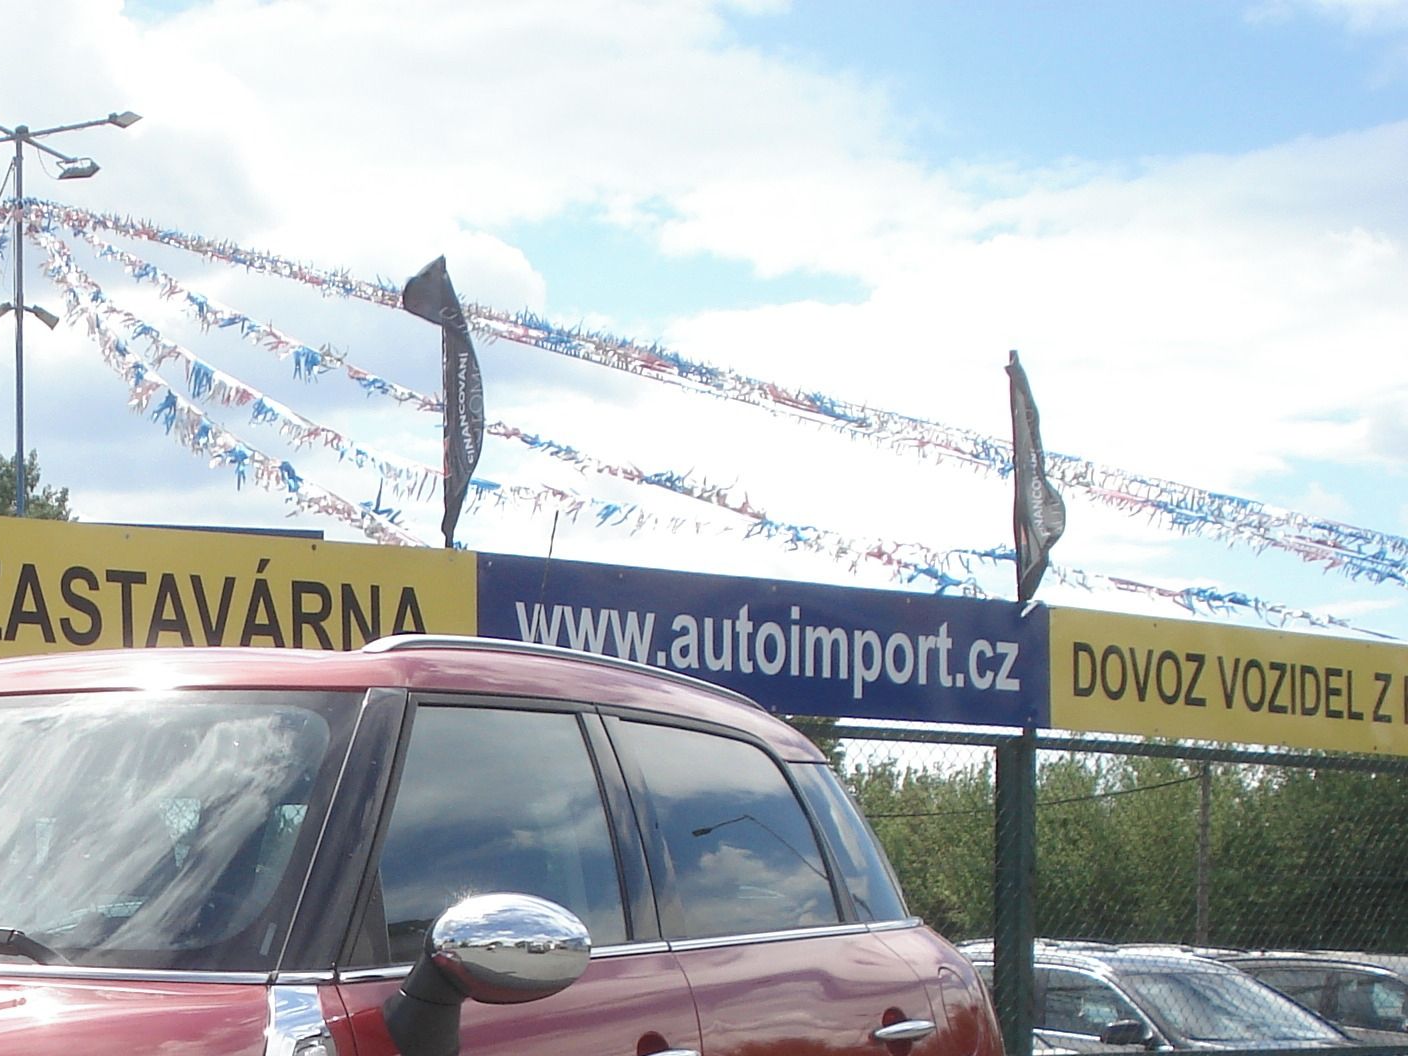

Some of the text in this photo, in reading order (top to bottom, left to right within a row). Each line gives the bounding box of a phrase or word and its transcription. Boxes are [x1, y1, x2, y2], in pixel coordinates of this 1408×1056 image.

[515, 601, 1021, 699] www.autoimport.cz
[1072, 641, 1207, 707] DOVOZ
[1217, 655, 1364, 721] VOZIDEL
[1372, 672, 1393, 723] Z
